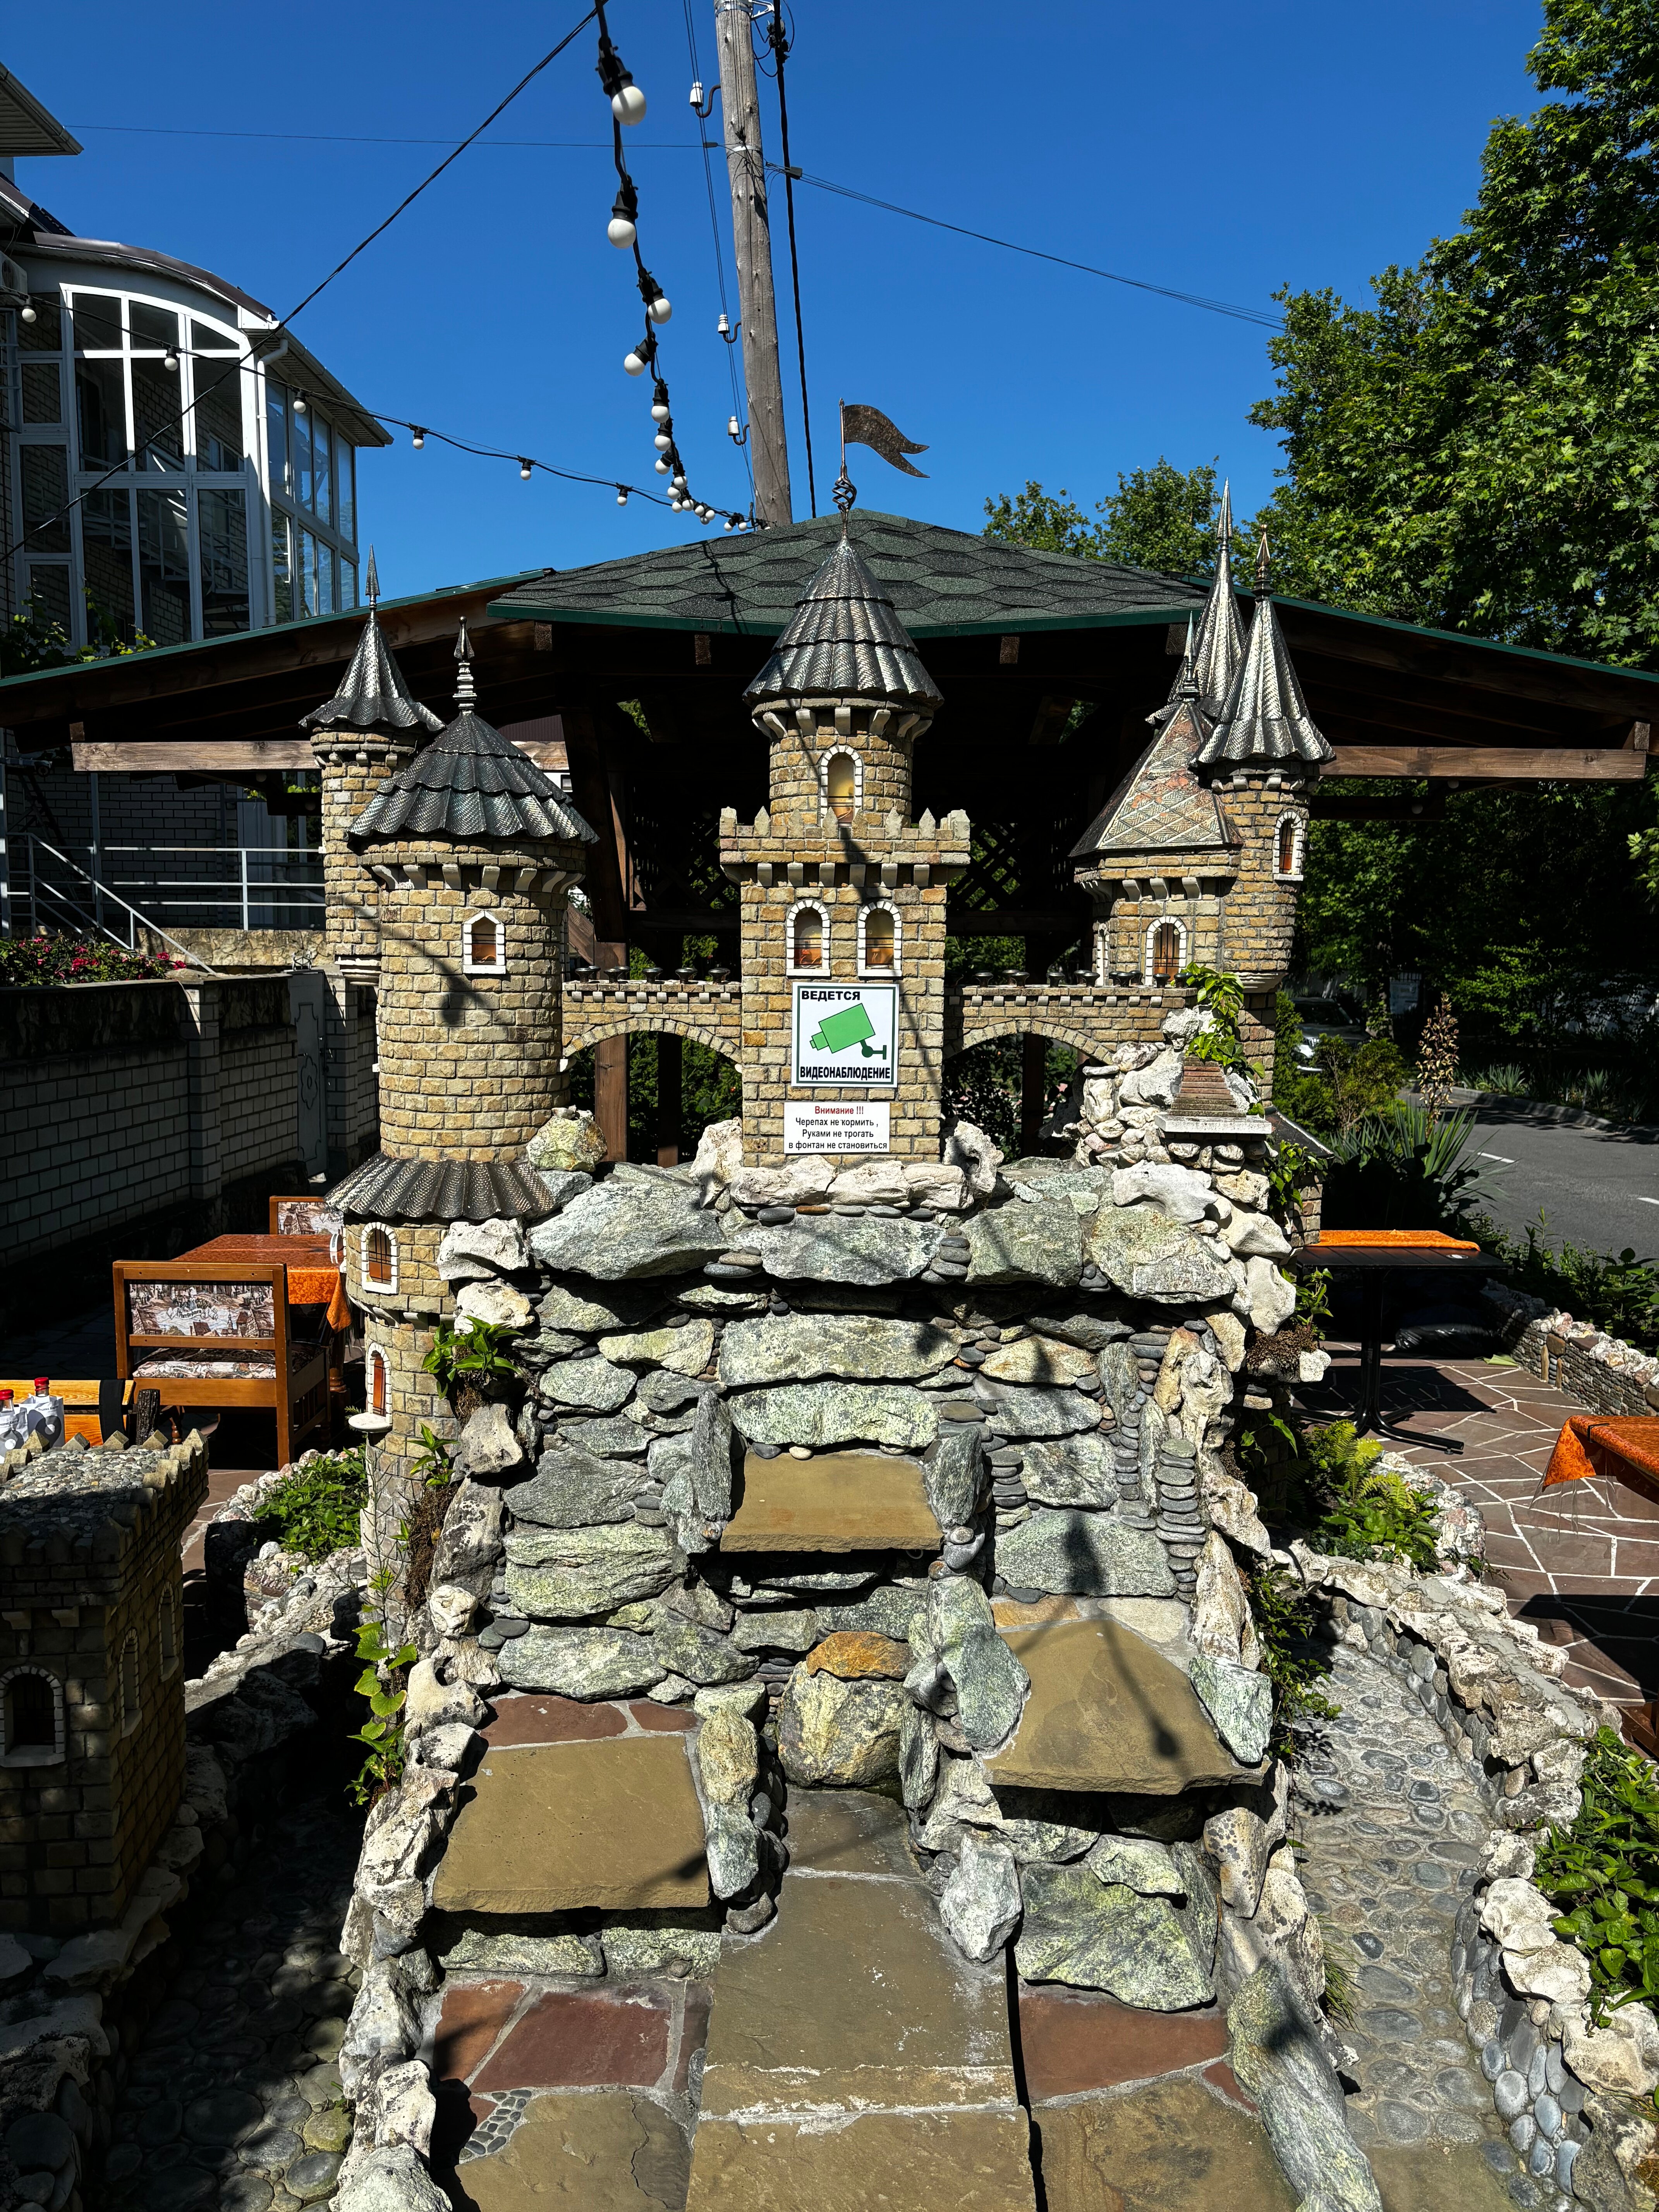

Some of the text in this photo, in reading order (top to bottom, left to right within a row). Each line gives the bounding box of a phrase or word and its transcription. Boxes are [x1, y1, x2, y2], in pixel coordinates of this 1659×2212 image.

[802, 991, 860, 1001] ВЕДЕТСЯ
[800, 1066, 890, 1080] ВИДЕОНАБЛЮДЕНИЕ
[815, 1106, 854, 1114] Внимание
[796, 1117, 828, 1128] Черепах
[840, 1120, 874, 1128] кормить
[802, 1129, 831, 1139] Руками
[795, 1140, 824, 1151] фонтан
